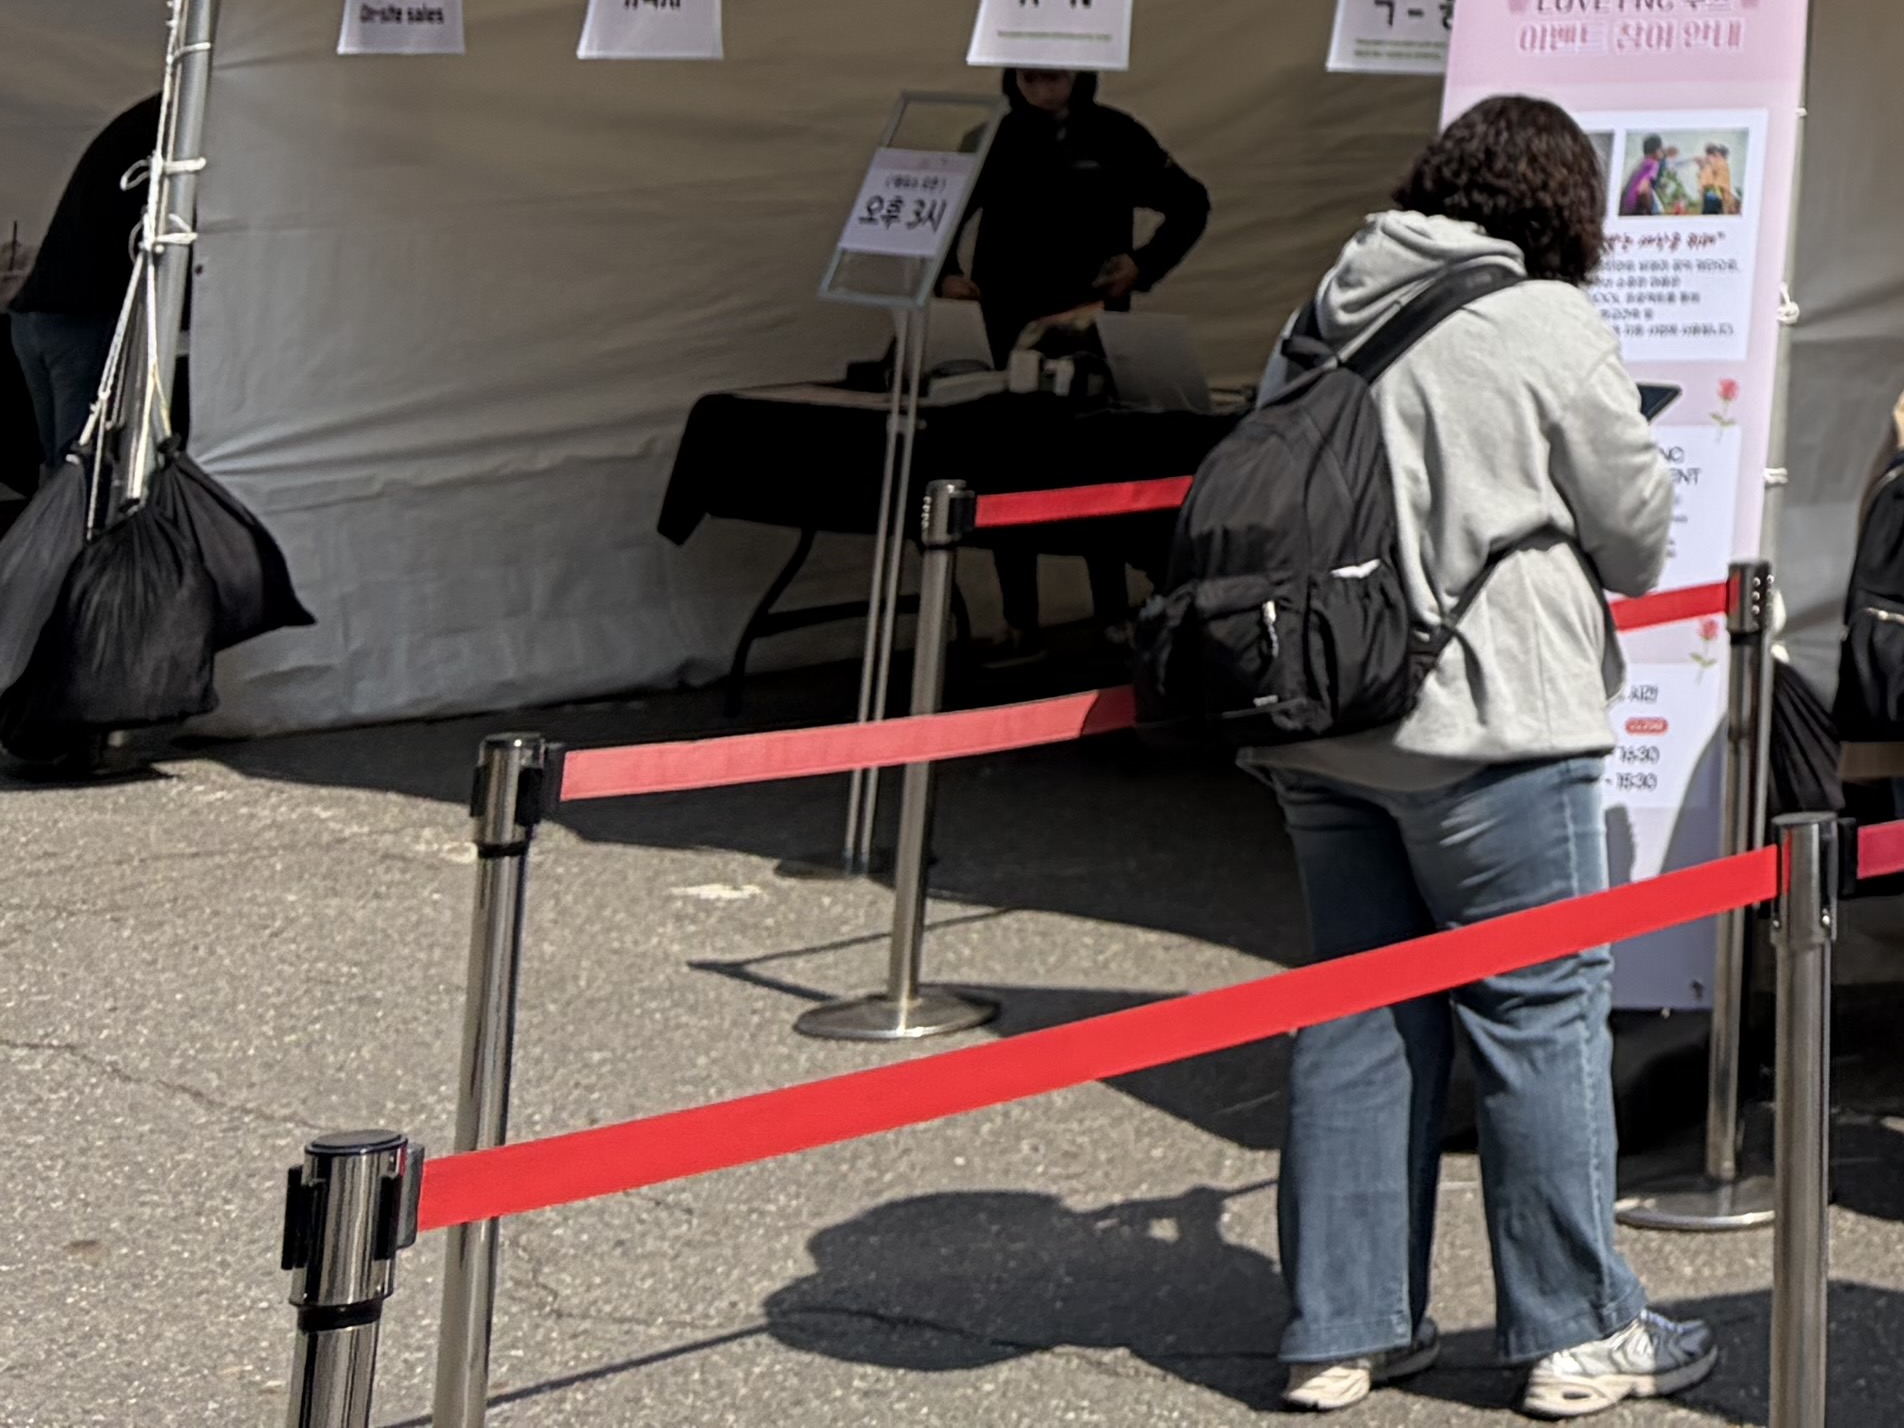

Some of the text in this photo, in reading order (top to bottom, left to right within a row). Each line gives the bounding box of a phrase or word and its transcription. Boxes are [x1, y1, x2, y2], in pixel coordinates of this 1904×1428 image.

[407, 4, 444, 25] sales
[1519, 22, 1604, 52] 이벤트
[1684, 20, 1742, 48] 안내
[858, 195, 947, 235] 오후 3시
